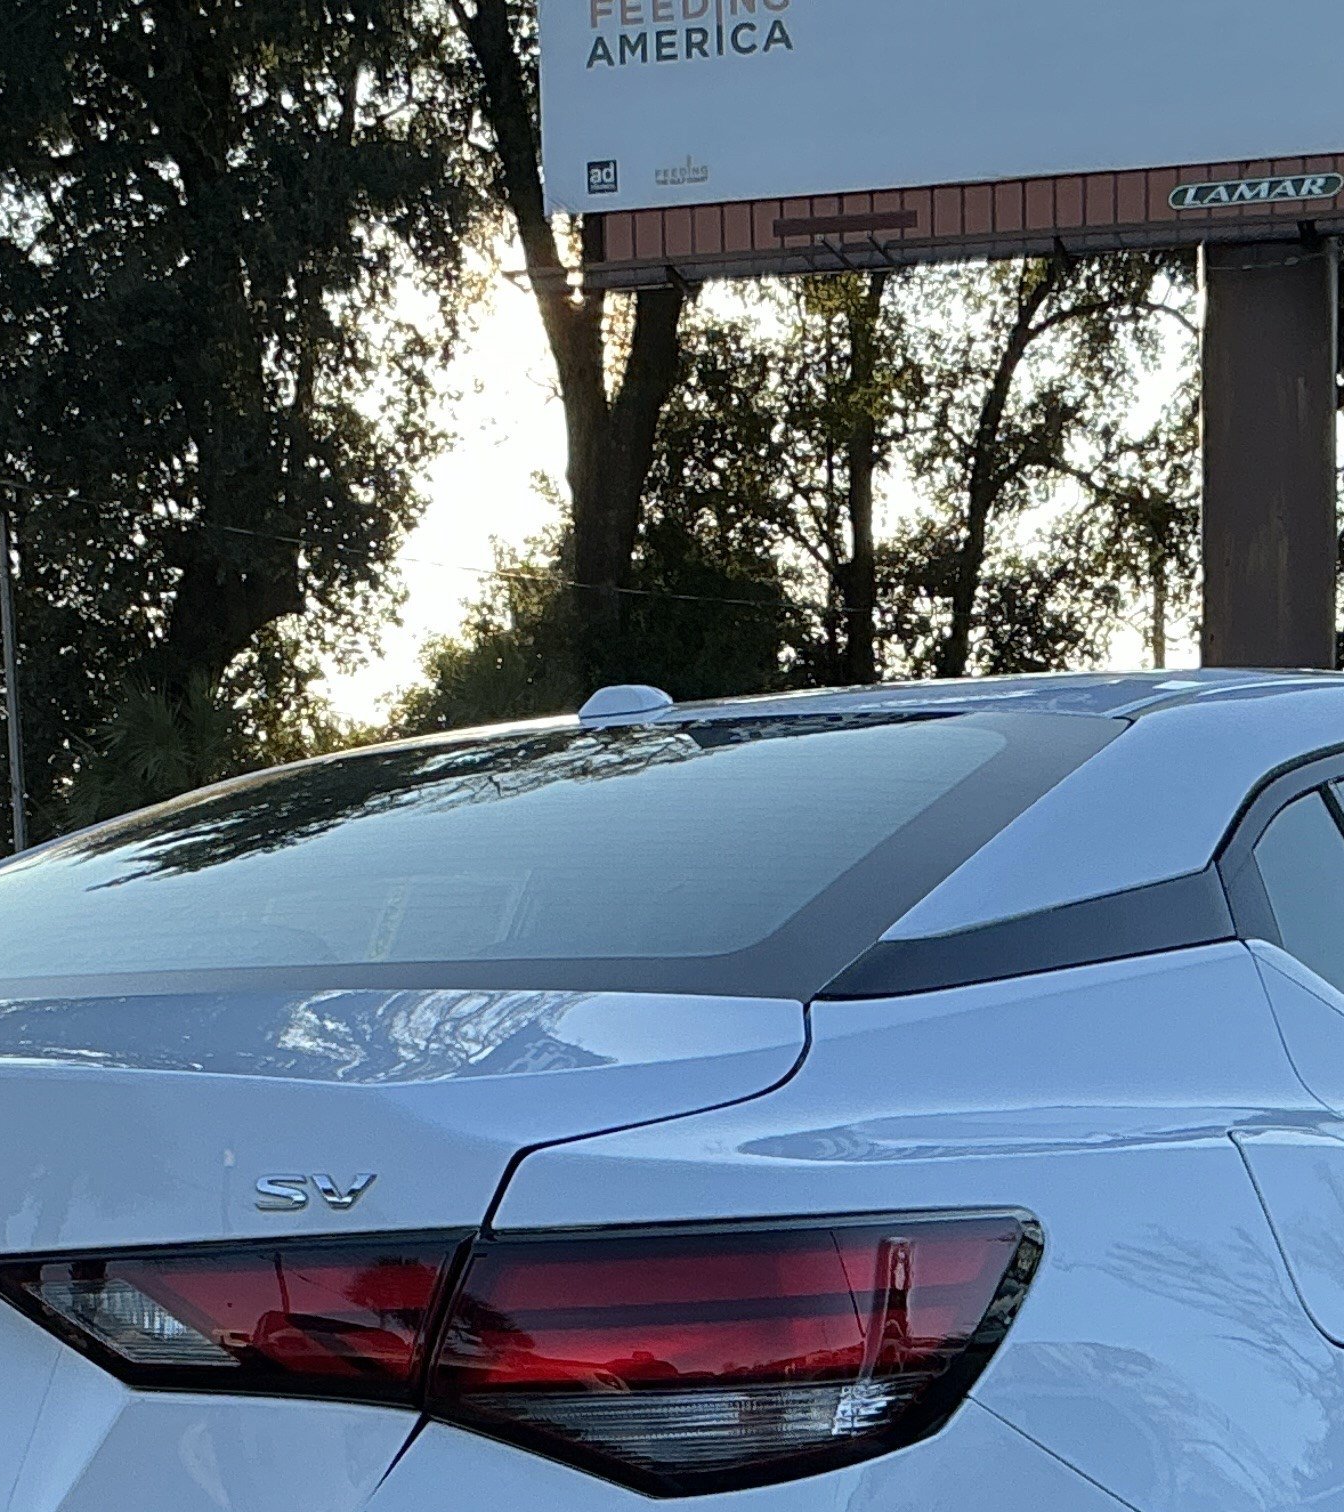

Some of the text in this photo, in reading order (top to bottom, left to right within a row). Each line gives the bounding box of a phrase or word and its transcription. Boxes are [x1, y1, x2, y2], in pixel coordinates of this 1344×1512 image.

[587, 19, 793, 69] AMERICA
[589, 162, 615, 184] ad
[1183, 177, 1326, 207] LAMAR
[255, 1173, 377, 1211] SV
